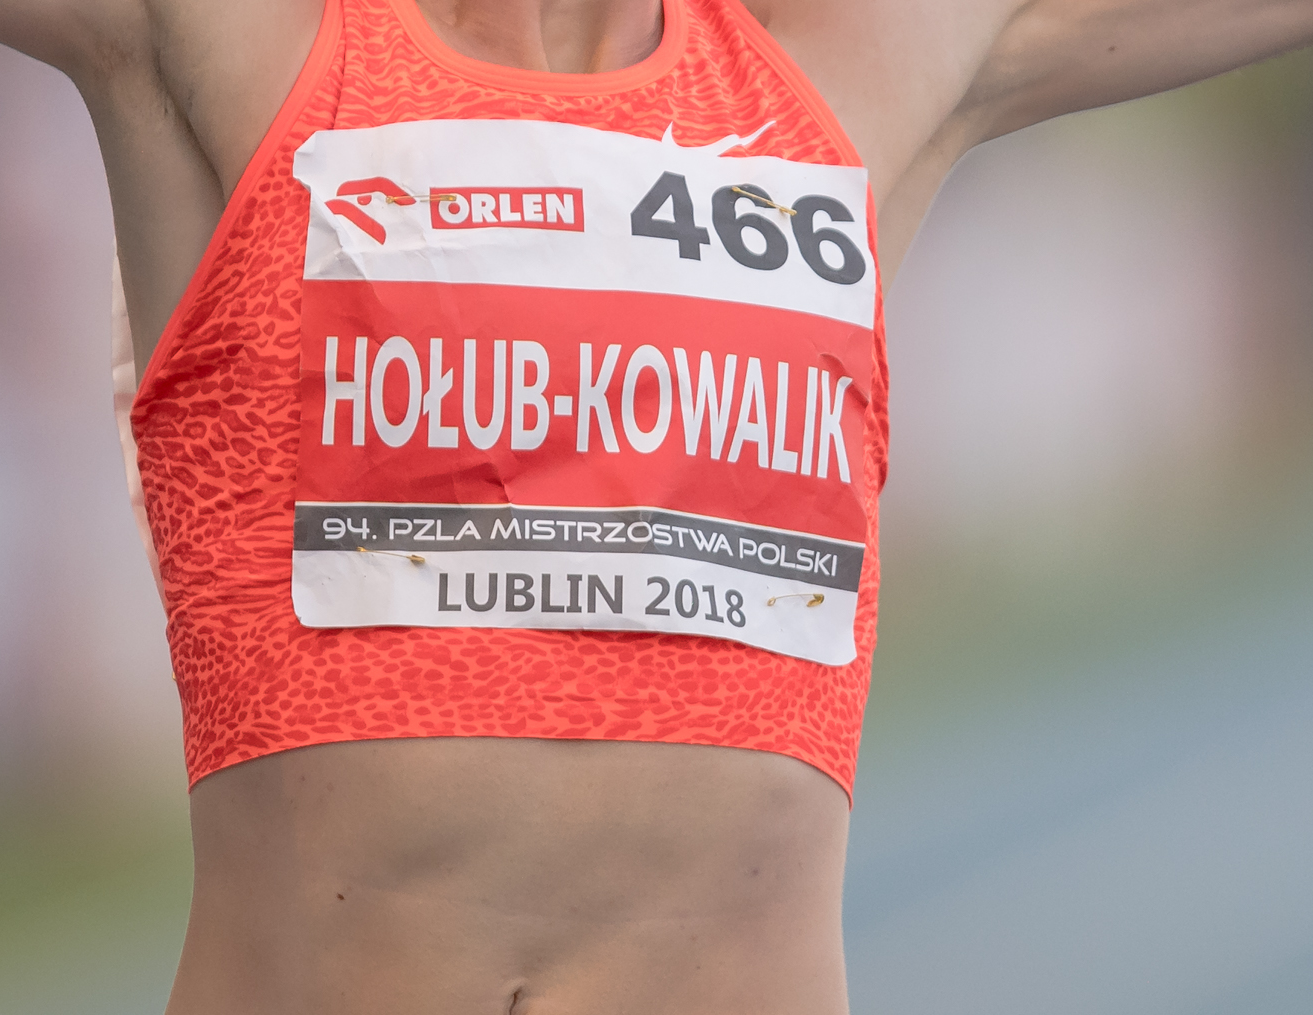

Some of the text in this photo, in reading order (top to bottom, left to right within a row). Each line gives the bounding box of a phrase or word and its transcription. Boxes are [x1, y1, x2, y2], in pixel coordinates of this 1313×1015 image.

[437, 192, 575, 224] ORLEN
[630, 170, 867, 286] 466
[321, 335, 854, 483] HOŁUB-KOWALIK
[321, 517, 839, 577] 94. PZLA MISTRZOSTWA POLSKI
[437, 572, 748, 629] LUBLIN 2018
